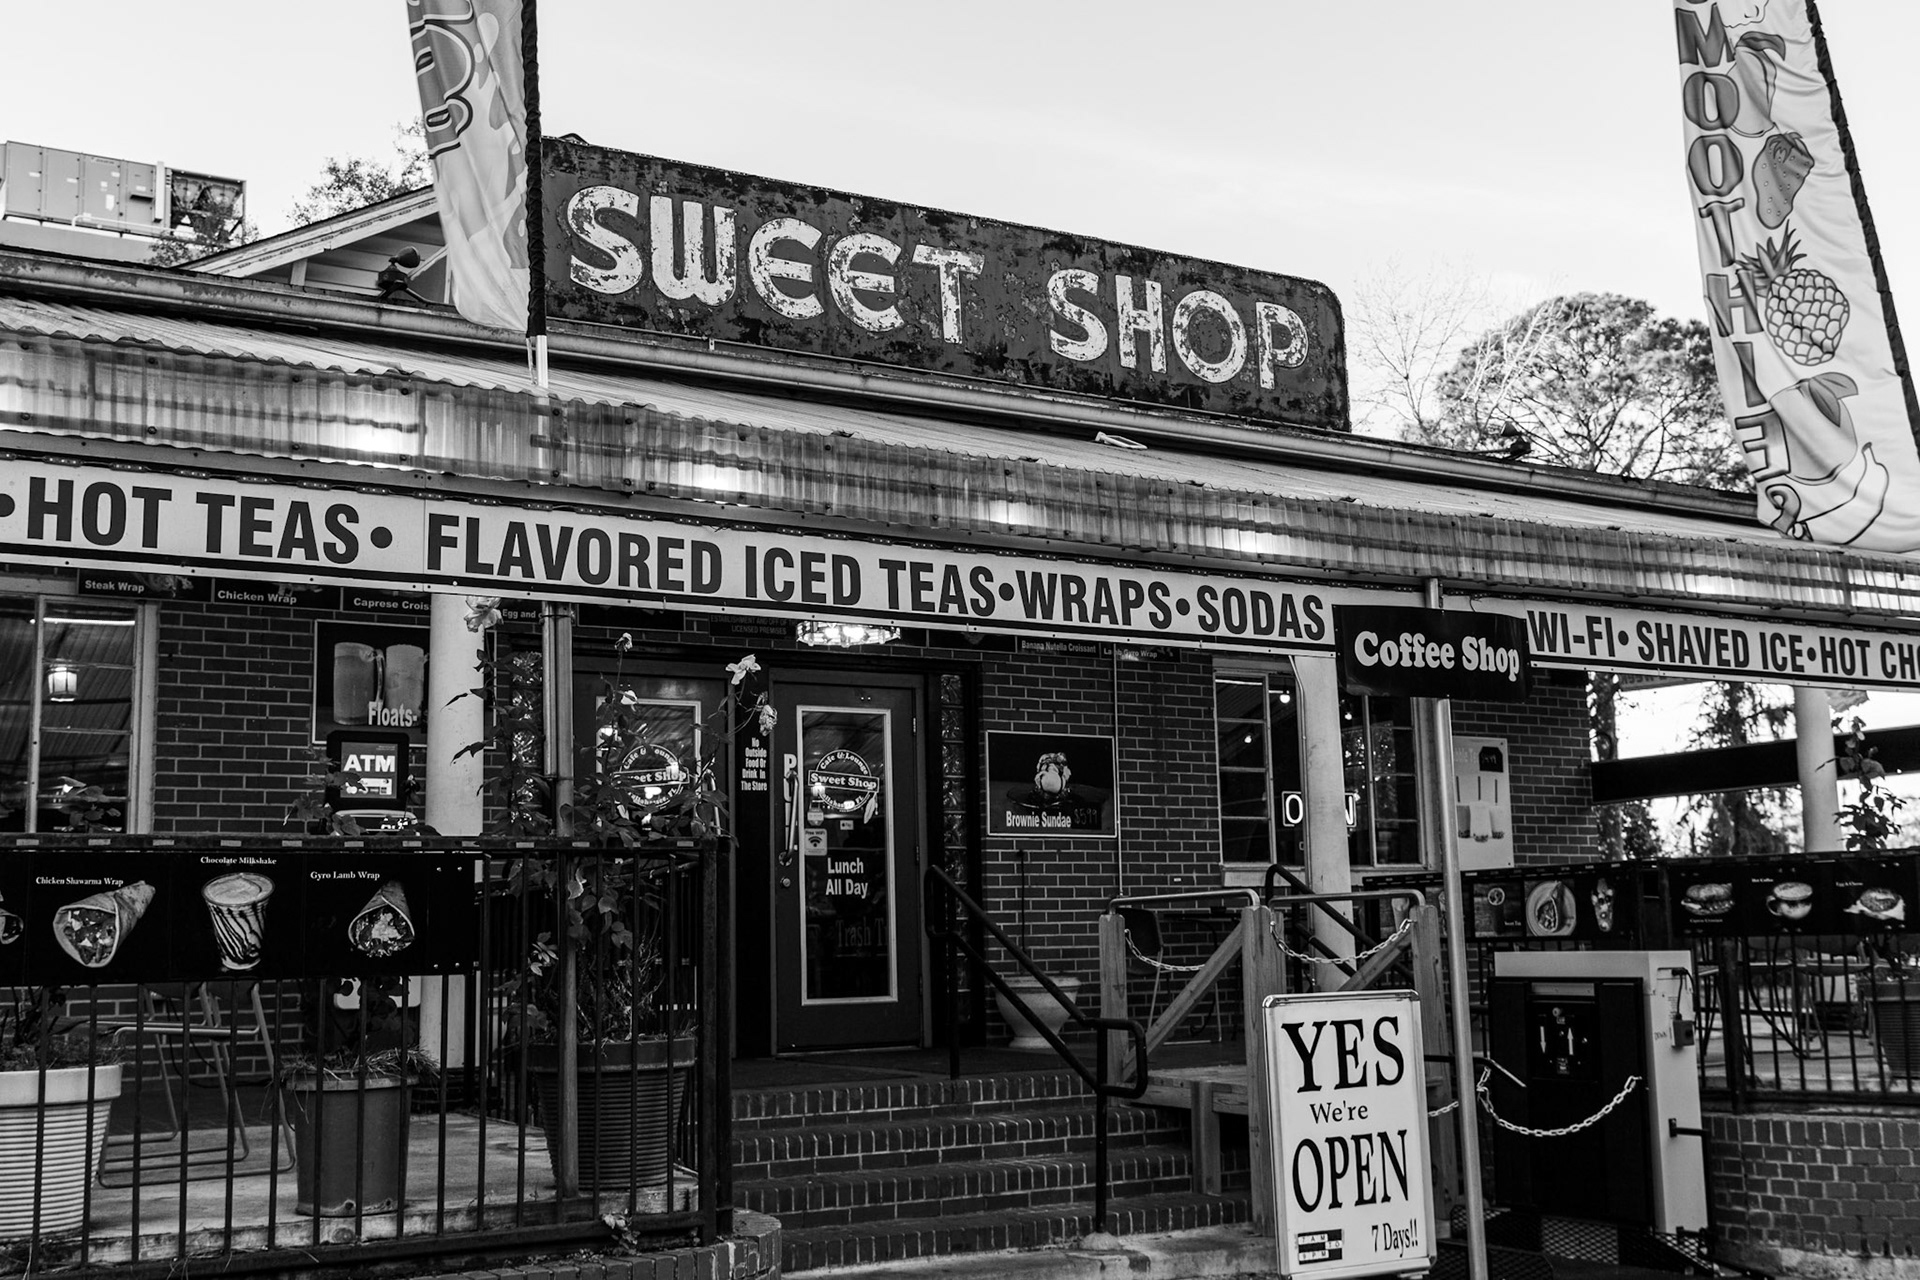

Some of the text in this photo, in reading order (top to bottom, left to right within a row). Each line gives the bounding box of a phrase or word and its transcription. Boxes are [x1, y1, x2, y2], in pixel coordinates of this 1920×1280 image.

[566, 184, 1309, 389] SWEET SHOP
[27, 477, 359, 564] HOT TEAS
[427, 513, 1326, 641] FLAVORED ICED TEAS WRAPS SODAS
[84, 580, 144, 594] Steak Wrap
[217, 590, 297, 606] Chicken Wrap
[353, 598, 431, 611] Caprese Crois
[502, 609, 518, 620] Egg
[520, 611, 536, 619] and
[1021, 640, 1096, 654] Banana Nutella Croissant
[1527, 610, 1920, 680] WI-FI SHAVED ICE HOT CH
[1140, 650, 1157, 660] Wrap
[1355, 630, 1520, 682] Coffee Shop
[745, 747, 767, 758] Outside
[343, 754, 396, 772] ATM
[745, 758, 759, 768] Food
[820, 754, 836, 770] Cafe
[845, 752, 868, 775] Lounge
[742, 768, 758, 779] Drink
[811, 773, 877, 790] Sweet Shop
[741, 780, 767, 791] The Store
[1006, 810, 1072, 828] Brownie Sundae
[200, 856, 277, 866] Chocolate Milkshake
[827, 857, 864, 874] Lunch
[36, 876, 124, 888] Chicken Shawarma Wrap
[310, 871, 380, 881] Gyro Lamb Wrap
[825, 878, 868, 899] All Day
[835, 915, 872, 948] Trash
[1281, 1016, 1405, 1093] YES
[1310, 1101, 1368, 1124] We're
[1292, 1129, 1409, 1213] OPEN
[1371, 1218, 1418, 1257] 7 Days!!
